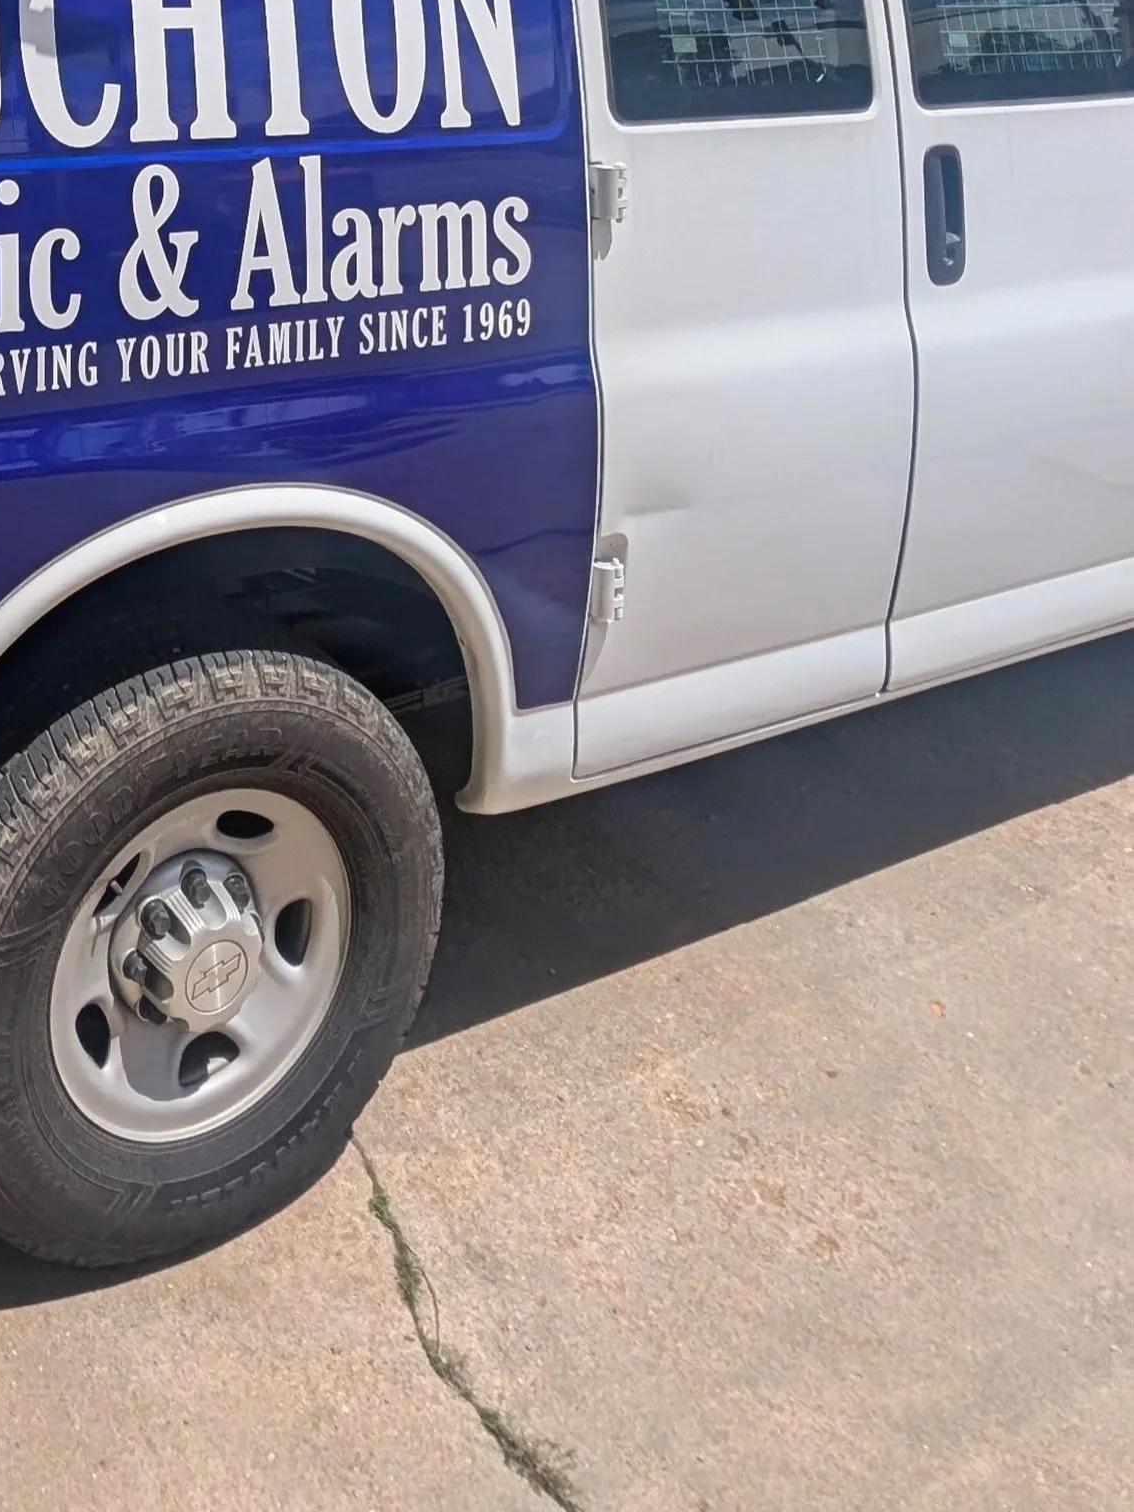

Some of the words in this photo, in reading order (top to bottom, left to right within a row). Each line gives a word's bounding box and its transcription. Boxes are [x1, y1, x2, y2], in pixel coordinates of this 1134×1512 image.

[118, 163, 200, 321] &
[230, 154, 533, 311] Alarms
[115, 330, 210, 383] YOUR
[225, 315, 345, 371] FAMILY
[359, 305, 448, 355] SINCE
[462, 298, 531, 343] 1969
